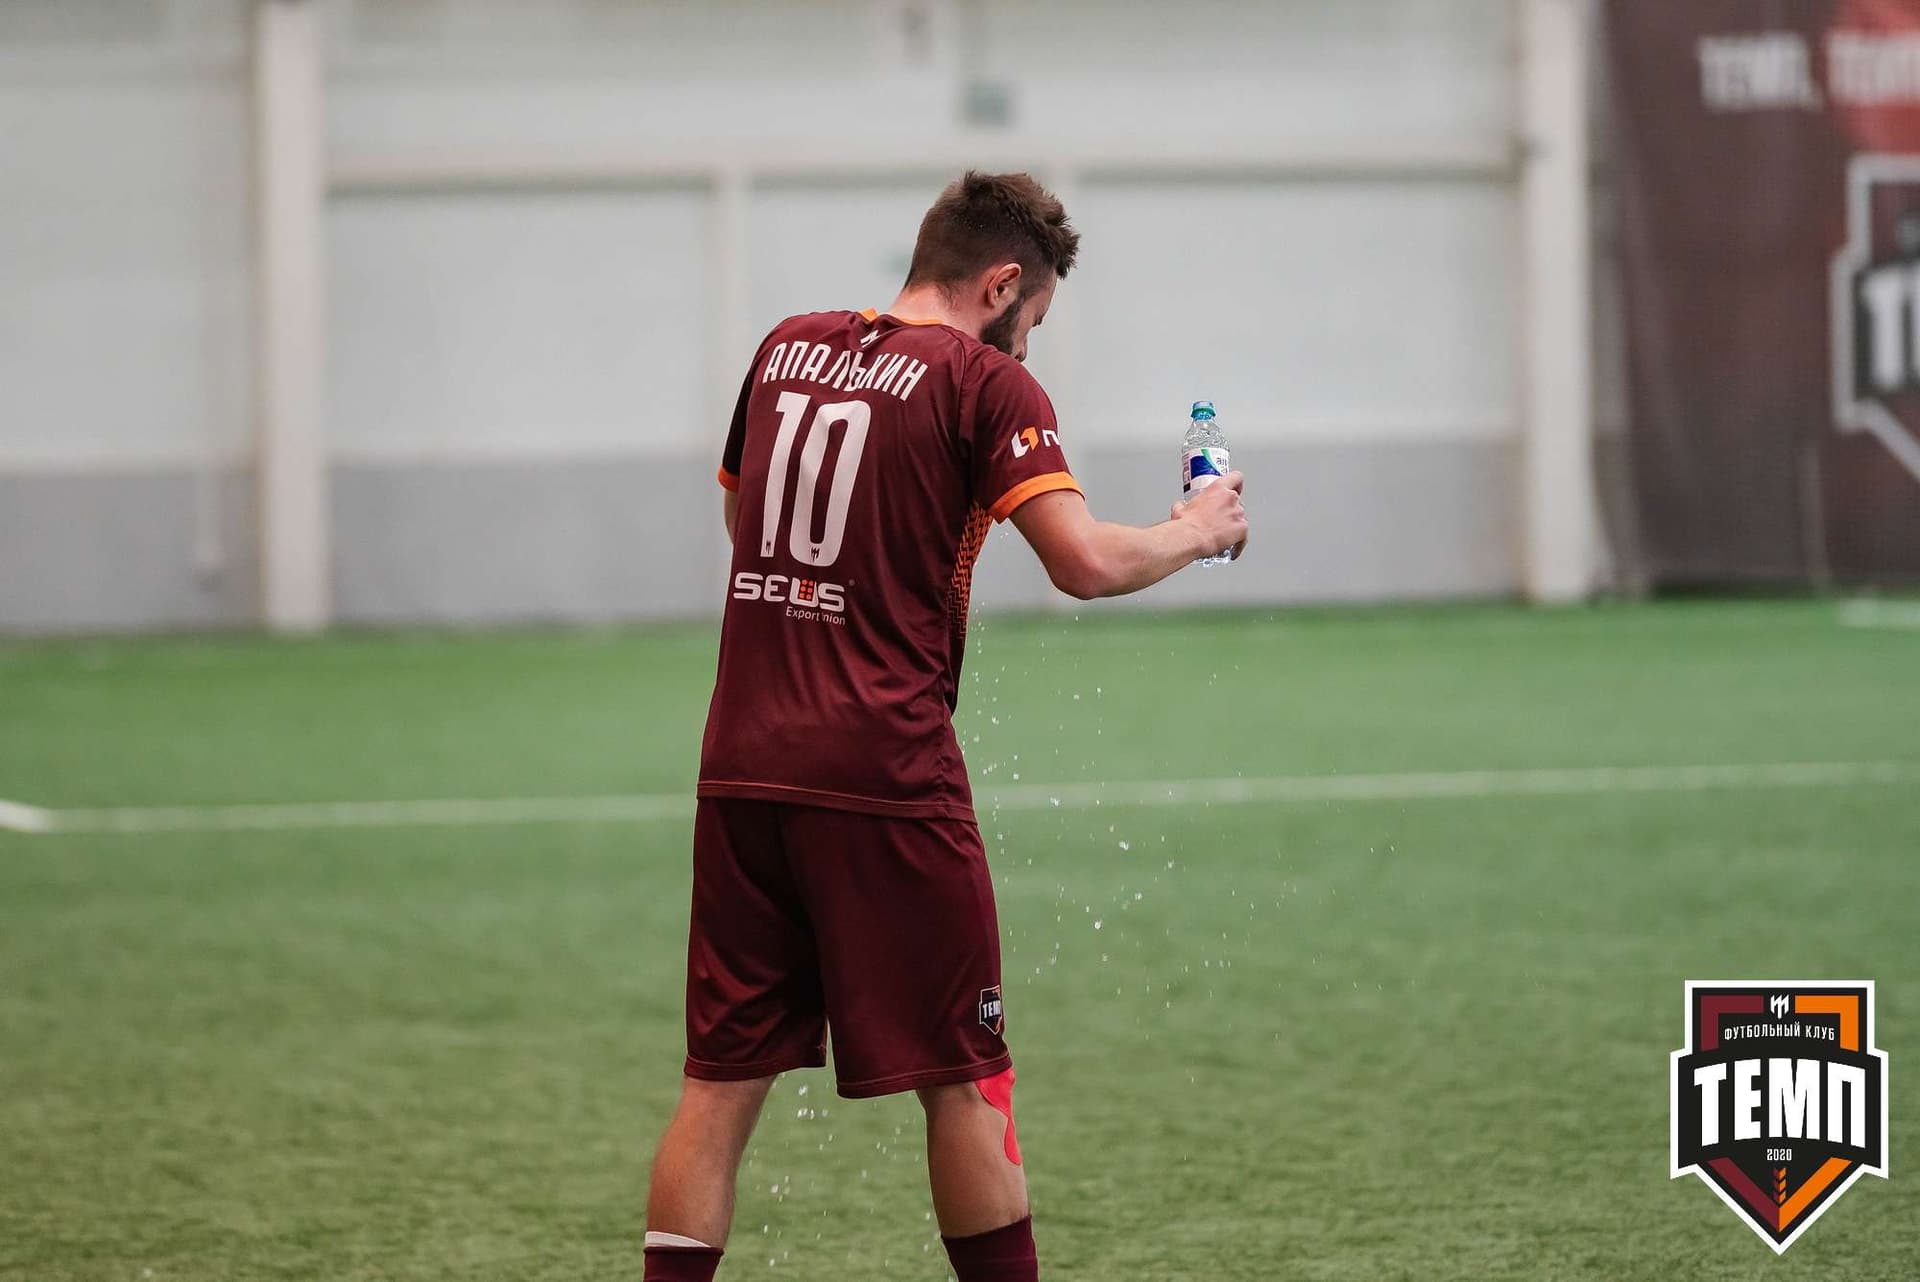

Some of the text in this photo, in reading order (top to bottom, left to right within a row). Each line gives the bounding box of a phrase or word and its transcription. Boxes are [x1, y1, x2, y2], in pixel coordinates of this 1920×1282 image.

[763, 341, 928, 401] АПАЛЬКИН
[760, 391, 871, 566] 10
[734, 572, 845, 612] SEUS
